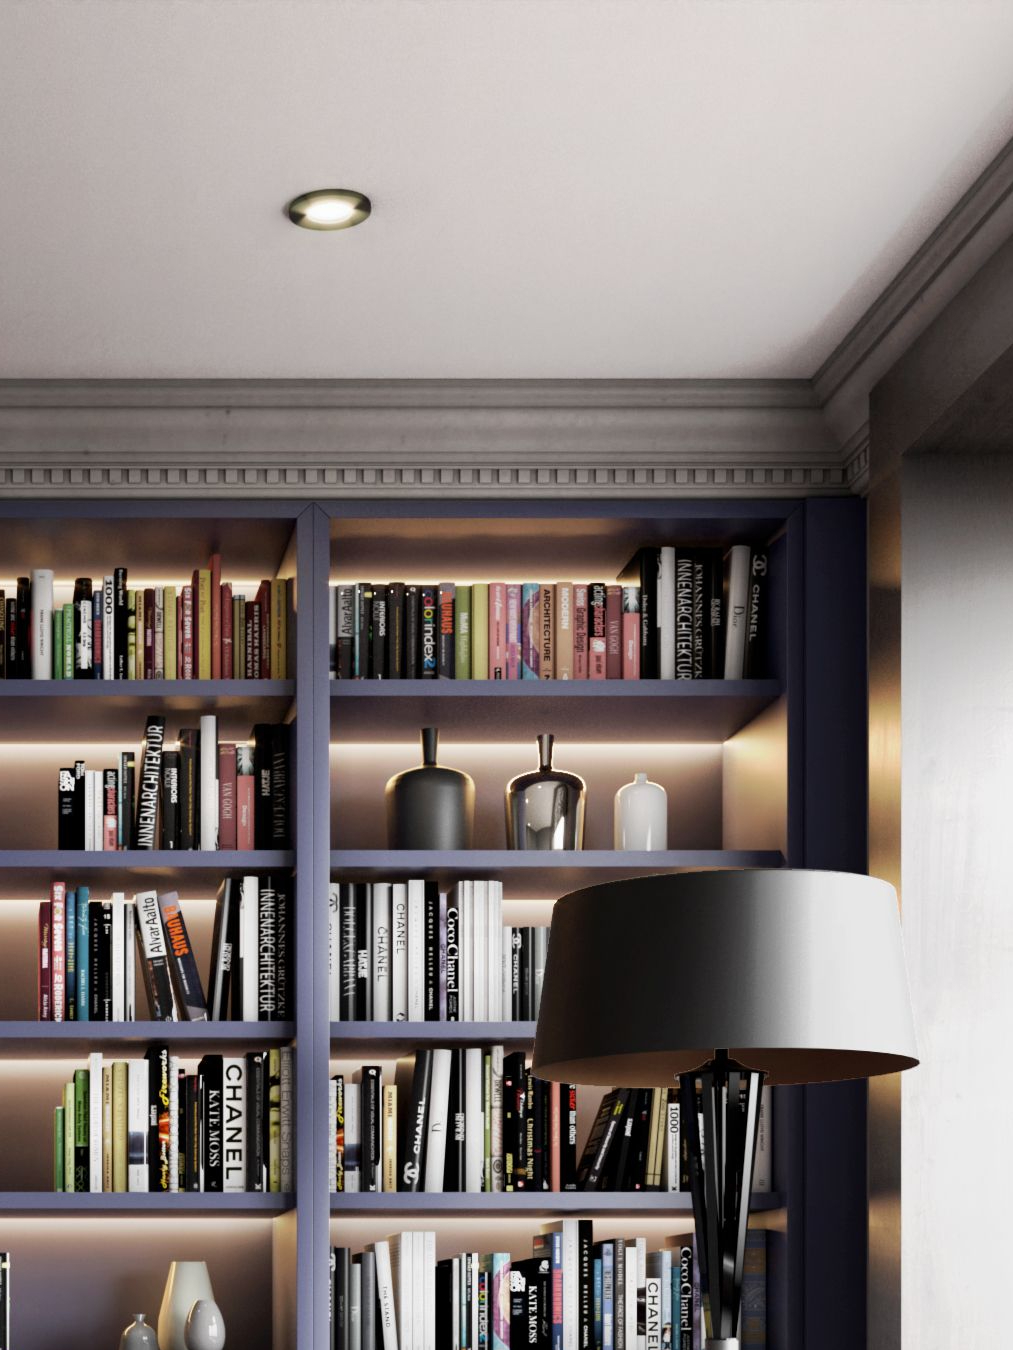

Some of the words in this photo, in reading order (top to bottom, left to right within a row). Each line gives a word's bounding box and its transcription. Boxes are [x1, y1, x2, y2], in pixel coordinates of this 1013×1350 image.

[105, 580, 113, 615] 1000
[441, 591, 453, 635] BAUHAUS
[561, 588, 569, 630] MODERN
[749, 583, 760, 642] CHANEL
[574, 607, 586, 631] Graphic
[609, 620, 619, 634] VAN
[676, 559, 693, 680] INNENARCHITEKTUR
[732, 606, 745, 628] Dior
[574, 632, 586, 653] Design
[609, 635, 619, 655] GOGH
[137, 725, 164, 846] INNENARCHITEKTUR
[170, 768, 178, 804] INTERIORS
[222, 783, 233, 798] VAN
[261, 769, 270, 796] HATJE
[222, 798, 233, 819] GOGH
[163, 905, 189, 957] BAUHAUS
[277, 893, 286, 958] JOHANNES
[396, 904, 405, 954] CHANEL
[447, 907, 458, 943] Coco
[259, 889, 276, 1012] INNENARCHITEKTUR
[358, 950, 368, 978] HATJE
[378, 927, 387, 982] CHANEL
[447, 943, 458, 992] Chanel
[277, 959, 286, 1017] GRÜTZKE
[281, 1052, 291, 1086] Elliott
[209, 1089, 220, 1127] KATE
[281, 1090, 291, 1126] Erwitt
[494, 1080, 502, 1102] ORWELL
[226, 1065, 242, 1180] CHANEL
[414, 1097, 425, 1154] CHANEL
[670, 1107, 678, 1133] 1000
[209, 1129, 220, 1167] MOSS
[281, 1131, 291, 1176] Snaps
[525, 1158, 533, 1180] Night
[680, 1247, 692, 1281] Coco
[528, 1285, 537, 1314] KATE
[680, 1282, 692, 1331] Chanel
[528, 1315, 537, 1344] MOSS
